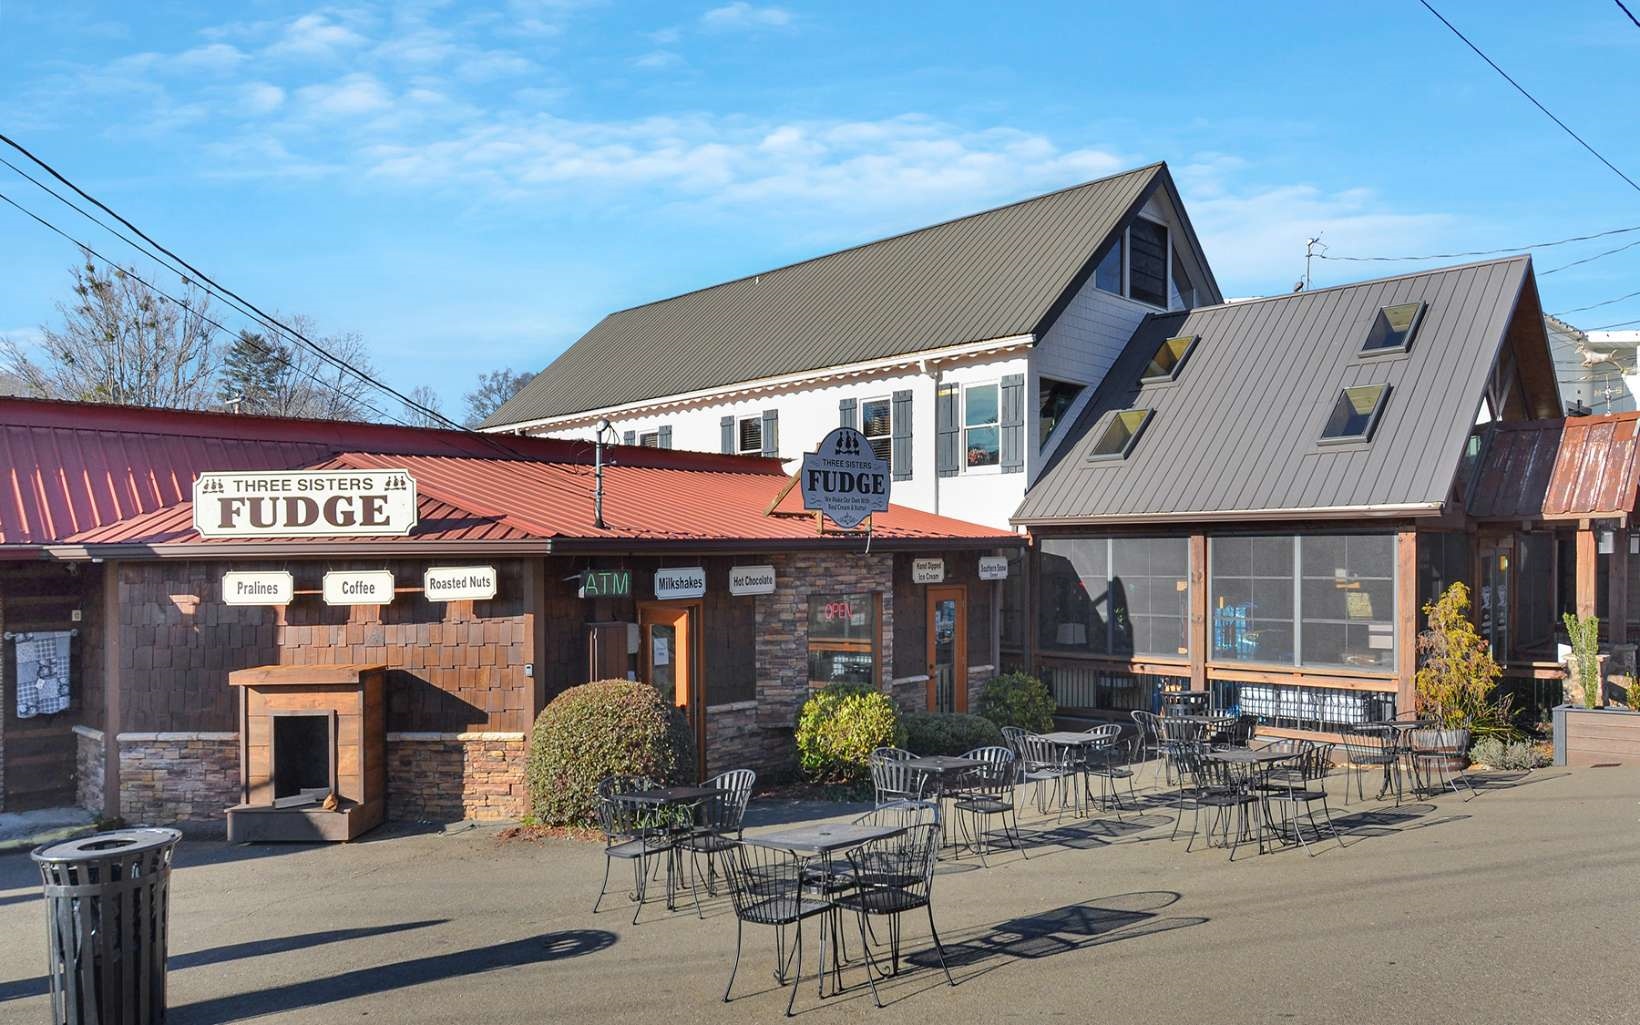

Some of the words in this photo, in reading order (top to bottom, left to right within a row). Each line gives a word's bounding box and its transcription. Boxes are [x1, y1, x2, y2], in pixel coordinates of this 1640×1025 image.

[823, 459, 844, 468] THREE
[845, 460, 872, 470] SISTERS
[233, 479, 292, 492] THREE
[297, 478, 374, 491] SISTERS
[807, 469, 885, 495] FUDGE
[217, 495, 390, 528] FUDGE
[237, 581, 278, 595] Pralines
[342, 580, 376, 595] Coffee
[429, 577, 467, 590] Roasted
[469, 576, 491, 589] Nuts
[584, 572, 629, 595] ATM
[658, 575, 703, 591] Milkshakes
[733, 577, 744, 587] Hot
[744, 575, 773, 586] Chocolate
[825, 602, 853, 620] OPEN
